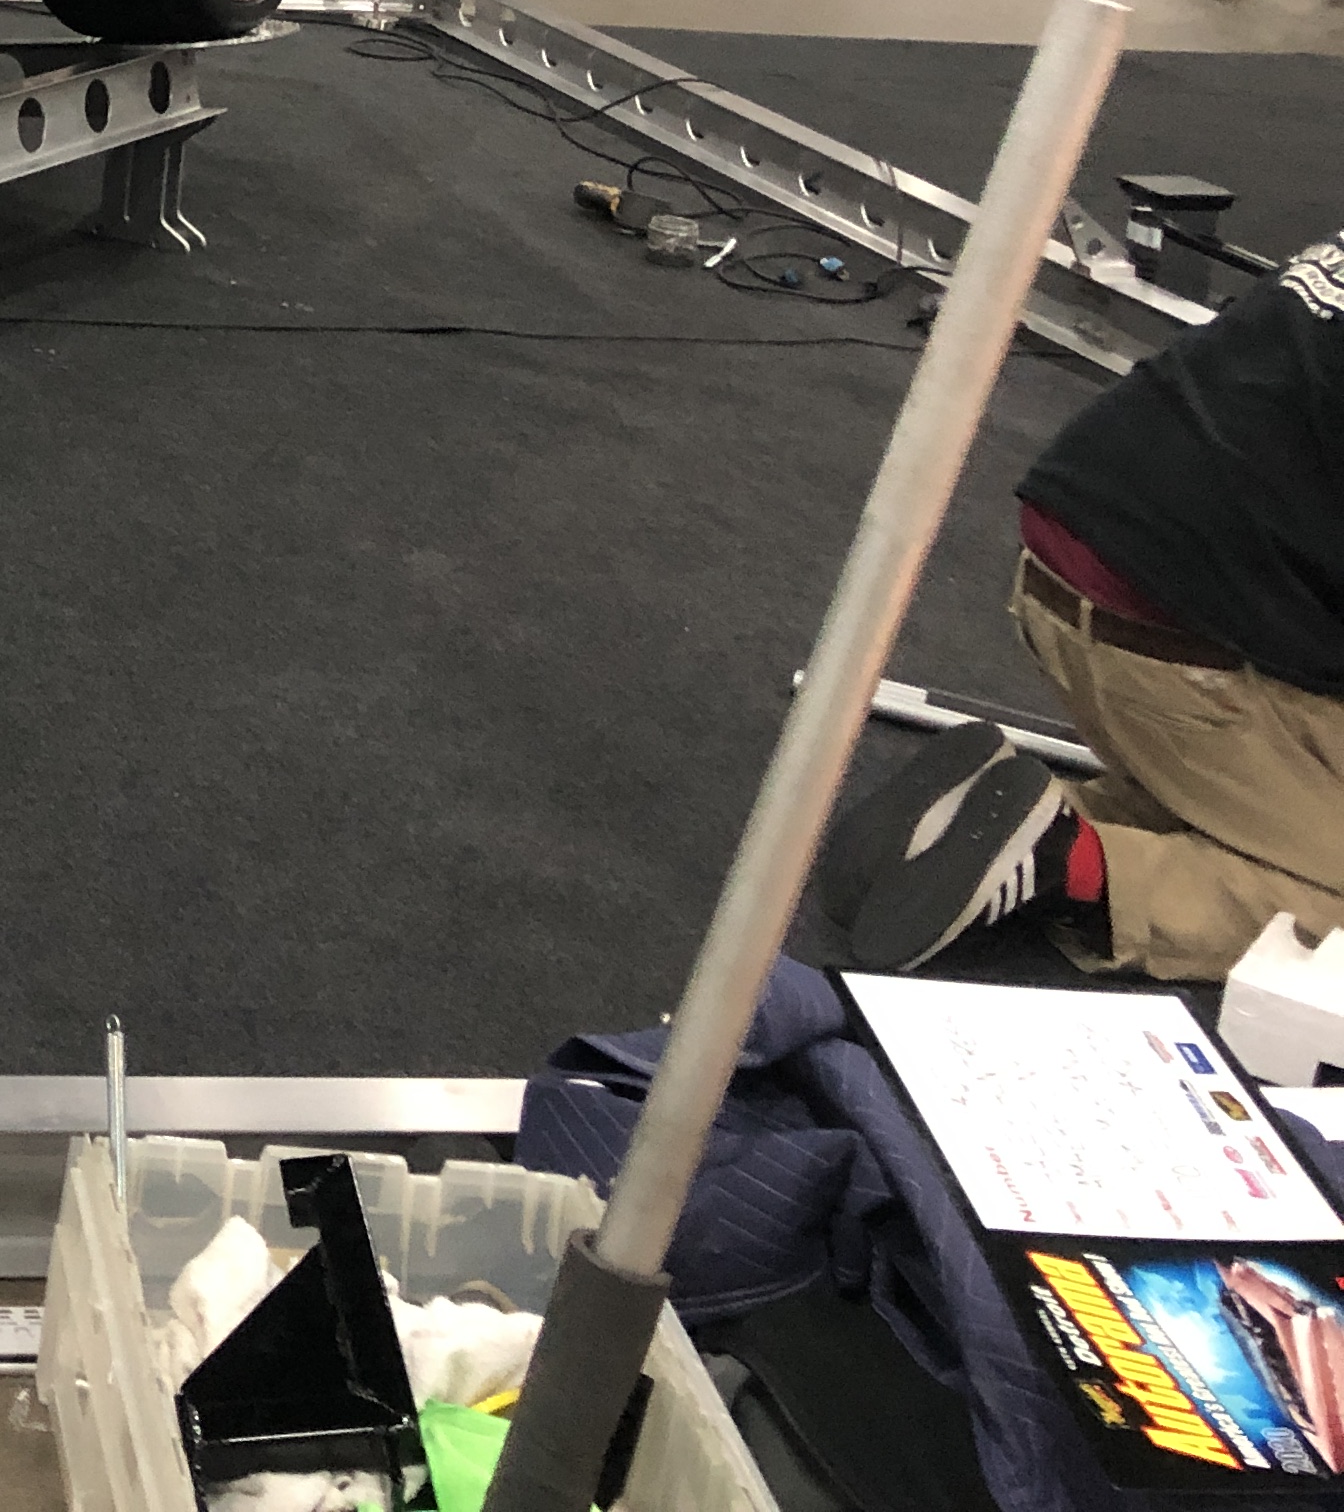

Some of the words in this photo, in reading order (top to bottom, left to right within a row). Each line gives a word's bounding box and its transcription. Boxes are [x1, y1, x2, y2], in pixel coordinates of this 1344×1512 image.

[984, 1146, 1036, 1223] Number
[1024, 1249, 1244, 1472] Autorama
[1029, 1284, 1103, 1367] Detroit
